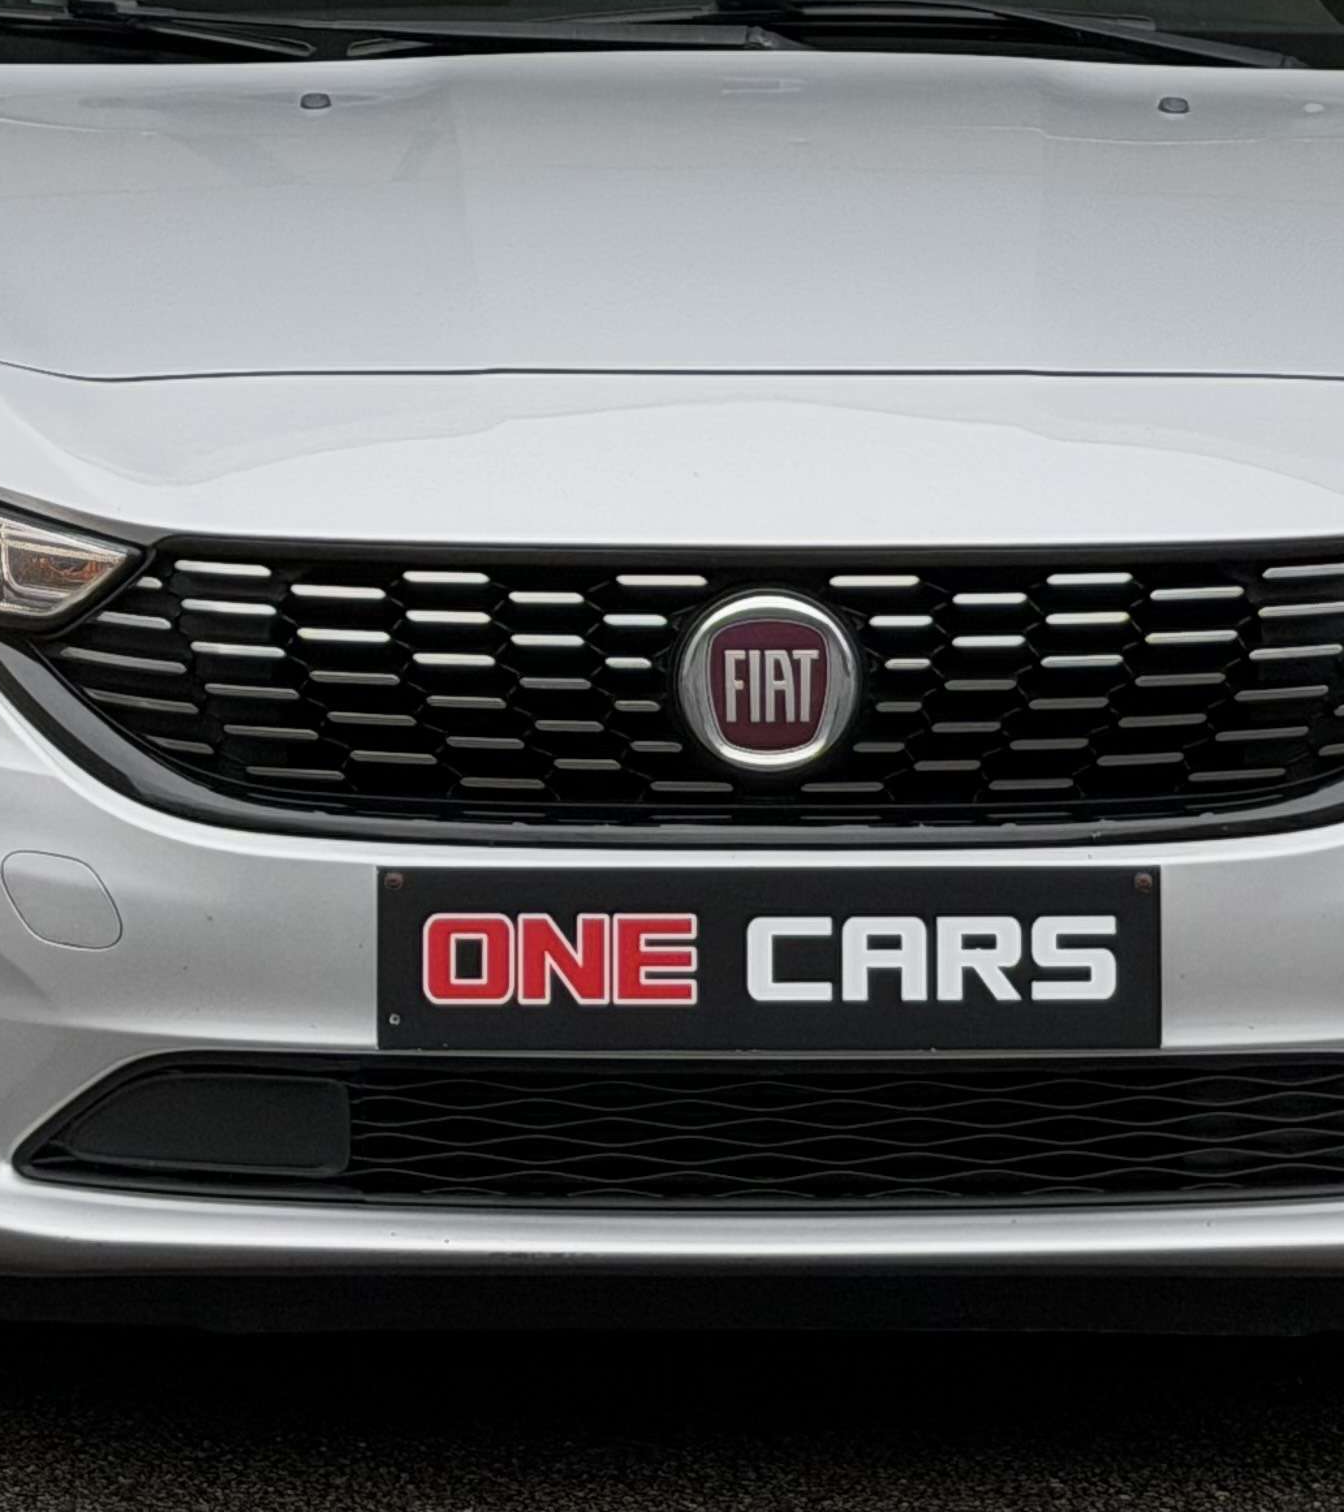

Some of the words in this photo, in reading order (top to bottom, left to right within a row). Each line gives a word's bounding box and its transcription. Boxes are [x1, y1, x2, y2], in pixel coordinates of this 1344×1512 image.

[723, 648, 820, 723] FIAT
[422, 912, 698, 1006] ONE
[746, 915, 1118, 1003] CARS
